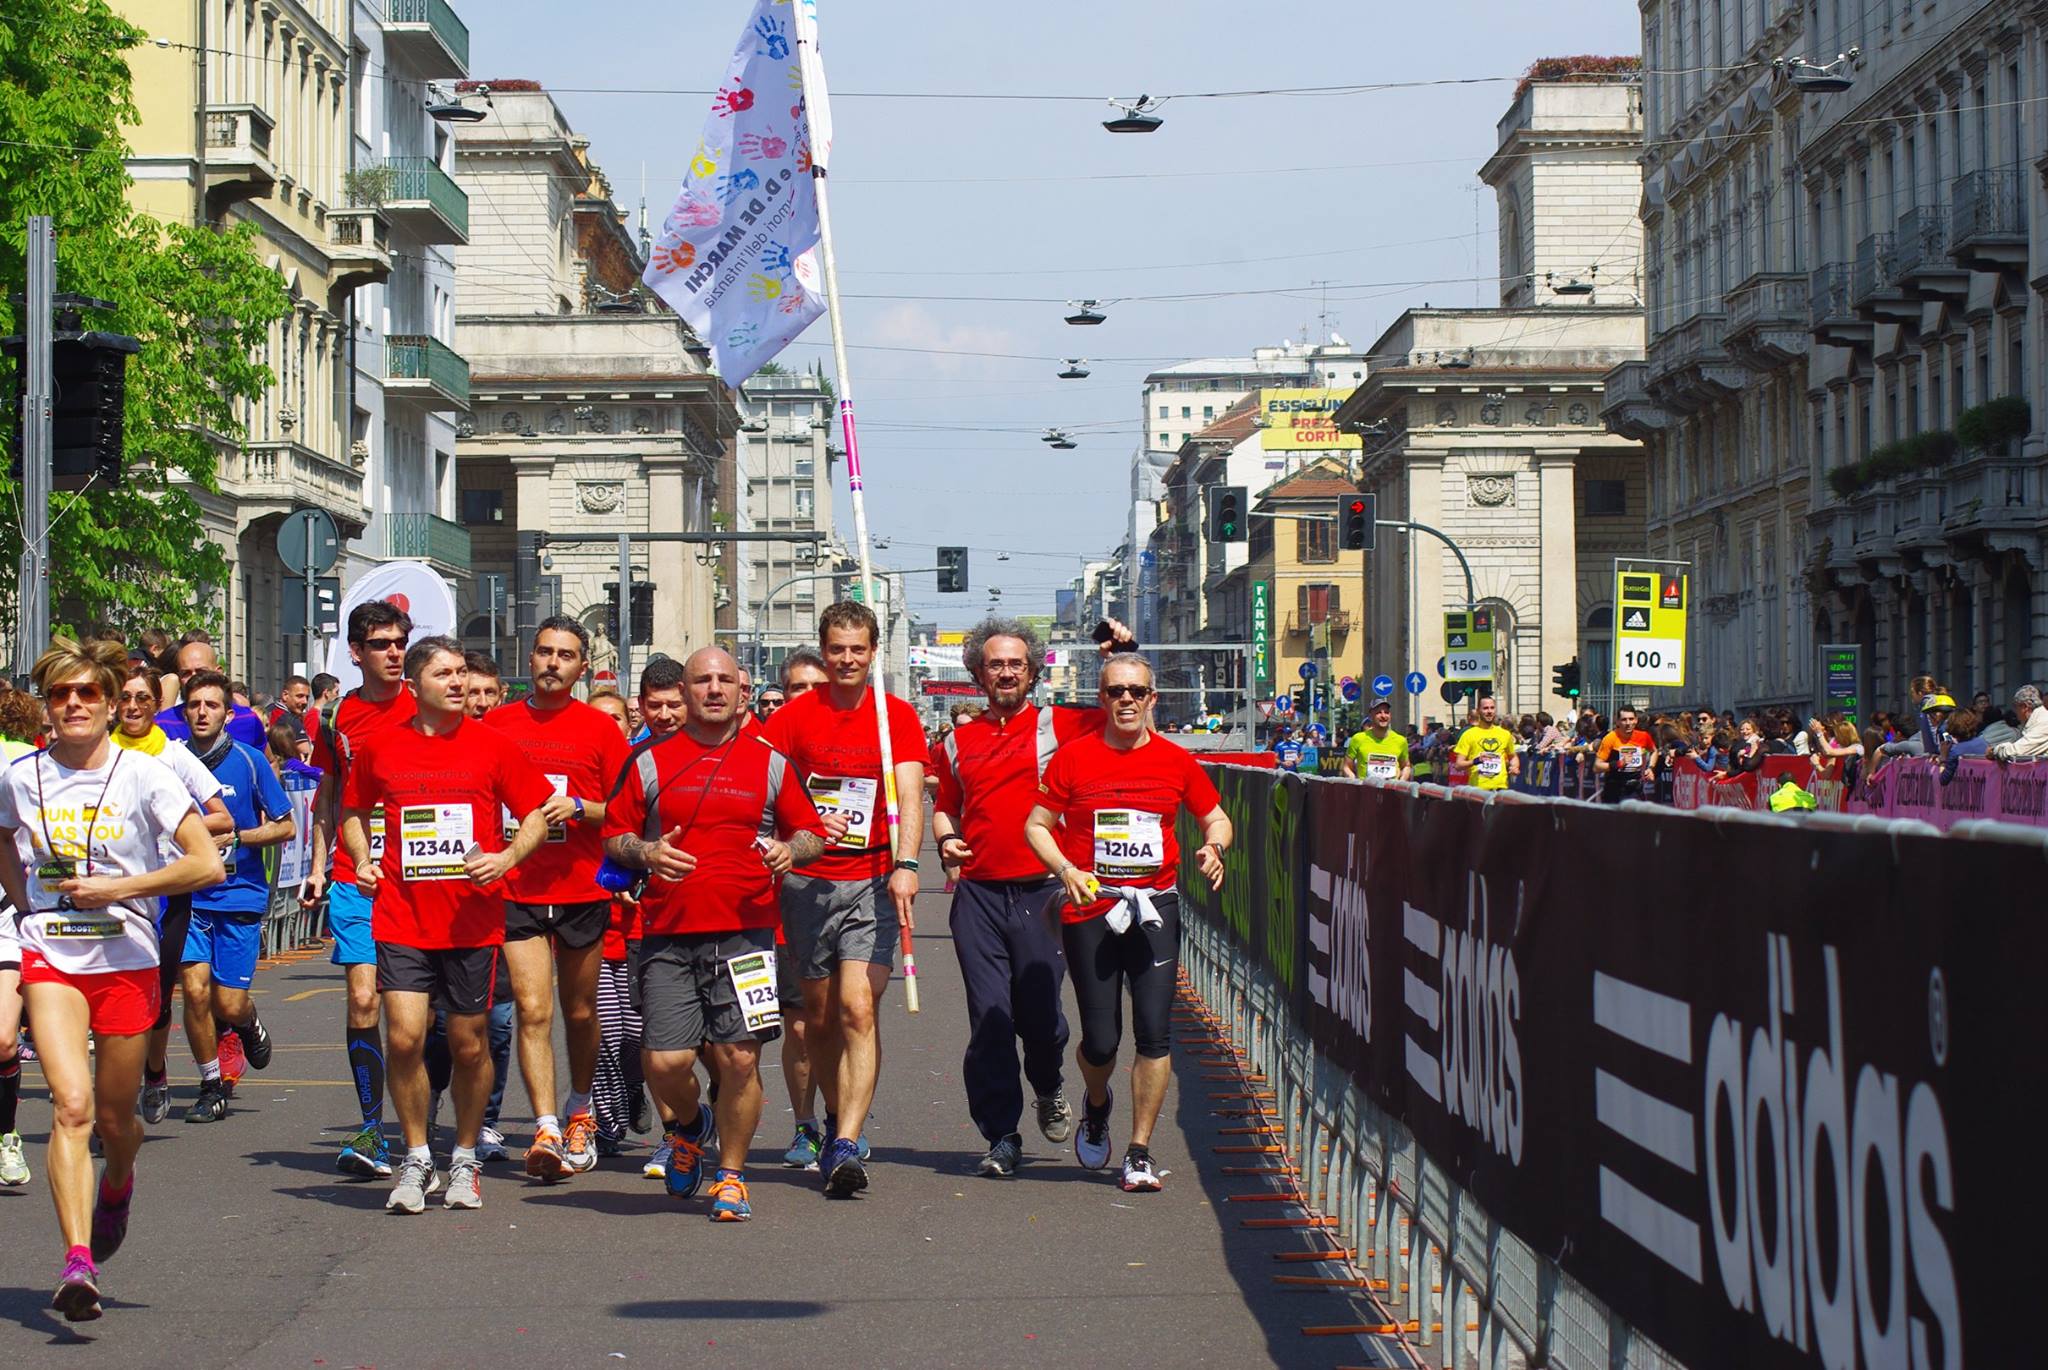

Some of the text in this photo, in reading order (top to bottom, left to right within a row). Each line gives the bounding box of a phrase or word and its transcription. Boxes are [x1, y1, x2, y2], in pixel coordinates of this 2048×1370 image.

[1295, 431, 1340, 443] CORTI
[1255, 585, 1266, 678] FARMACIA
[1450, 659, 1477, 671] 150
[1625, 650, 1677, 670] 100 m
[51, 825, 125, 841] AS YOU
[408, 839, 466, 856] 1234A
[1104, 841, 1154, 858] 1216A
[1331, 832, 1372, 1044] adidas
[1441, 869, 1524, 1168] adidas
[1704, 931, 1963, 1370] adidas
